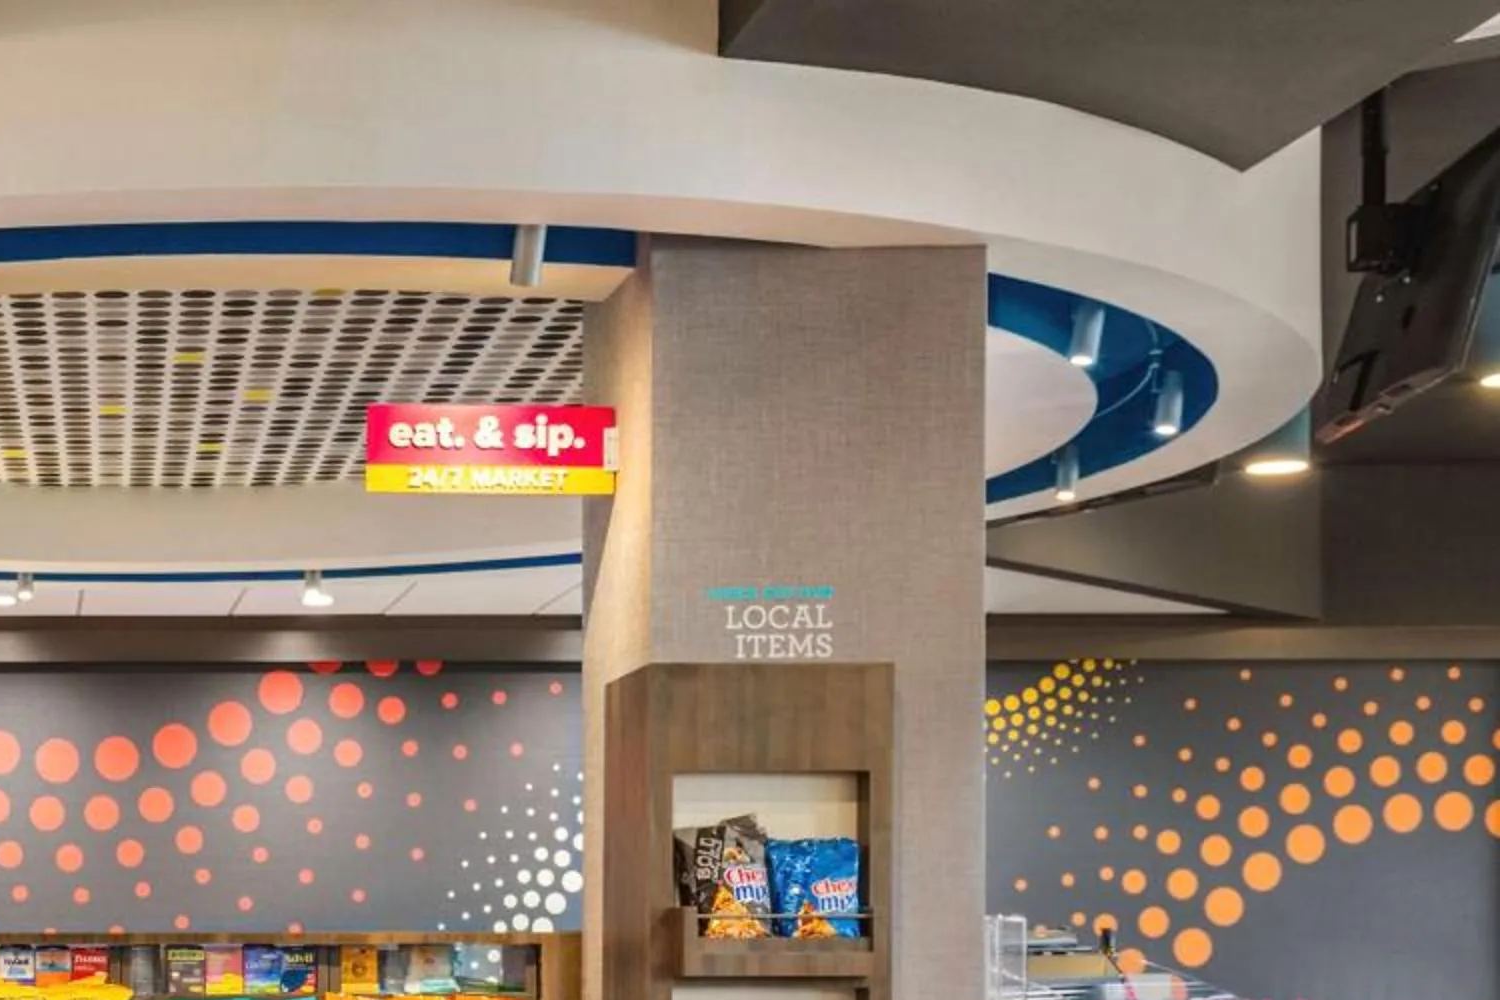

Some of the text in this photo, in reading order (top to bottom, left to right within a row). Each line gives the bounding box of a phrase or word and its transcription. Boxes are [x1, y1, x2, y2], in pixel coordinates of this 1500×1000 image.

[389, 414, 586, 457] eat. & sip.
[409, 467, 568, 489] 24/7 MARKET
[725, 604, 834, 629] LOCAL
[734, 634, 834, 659] ITEMS
